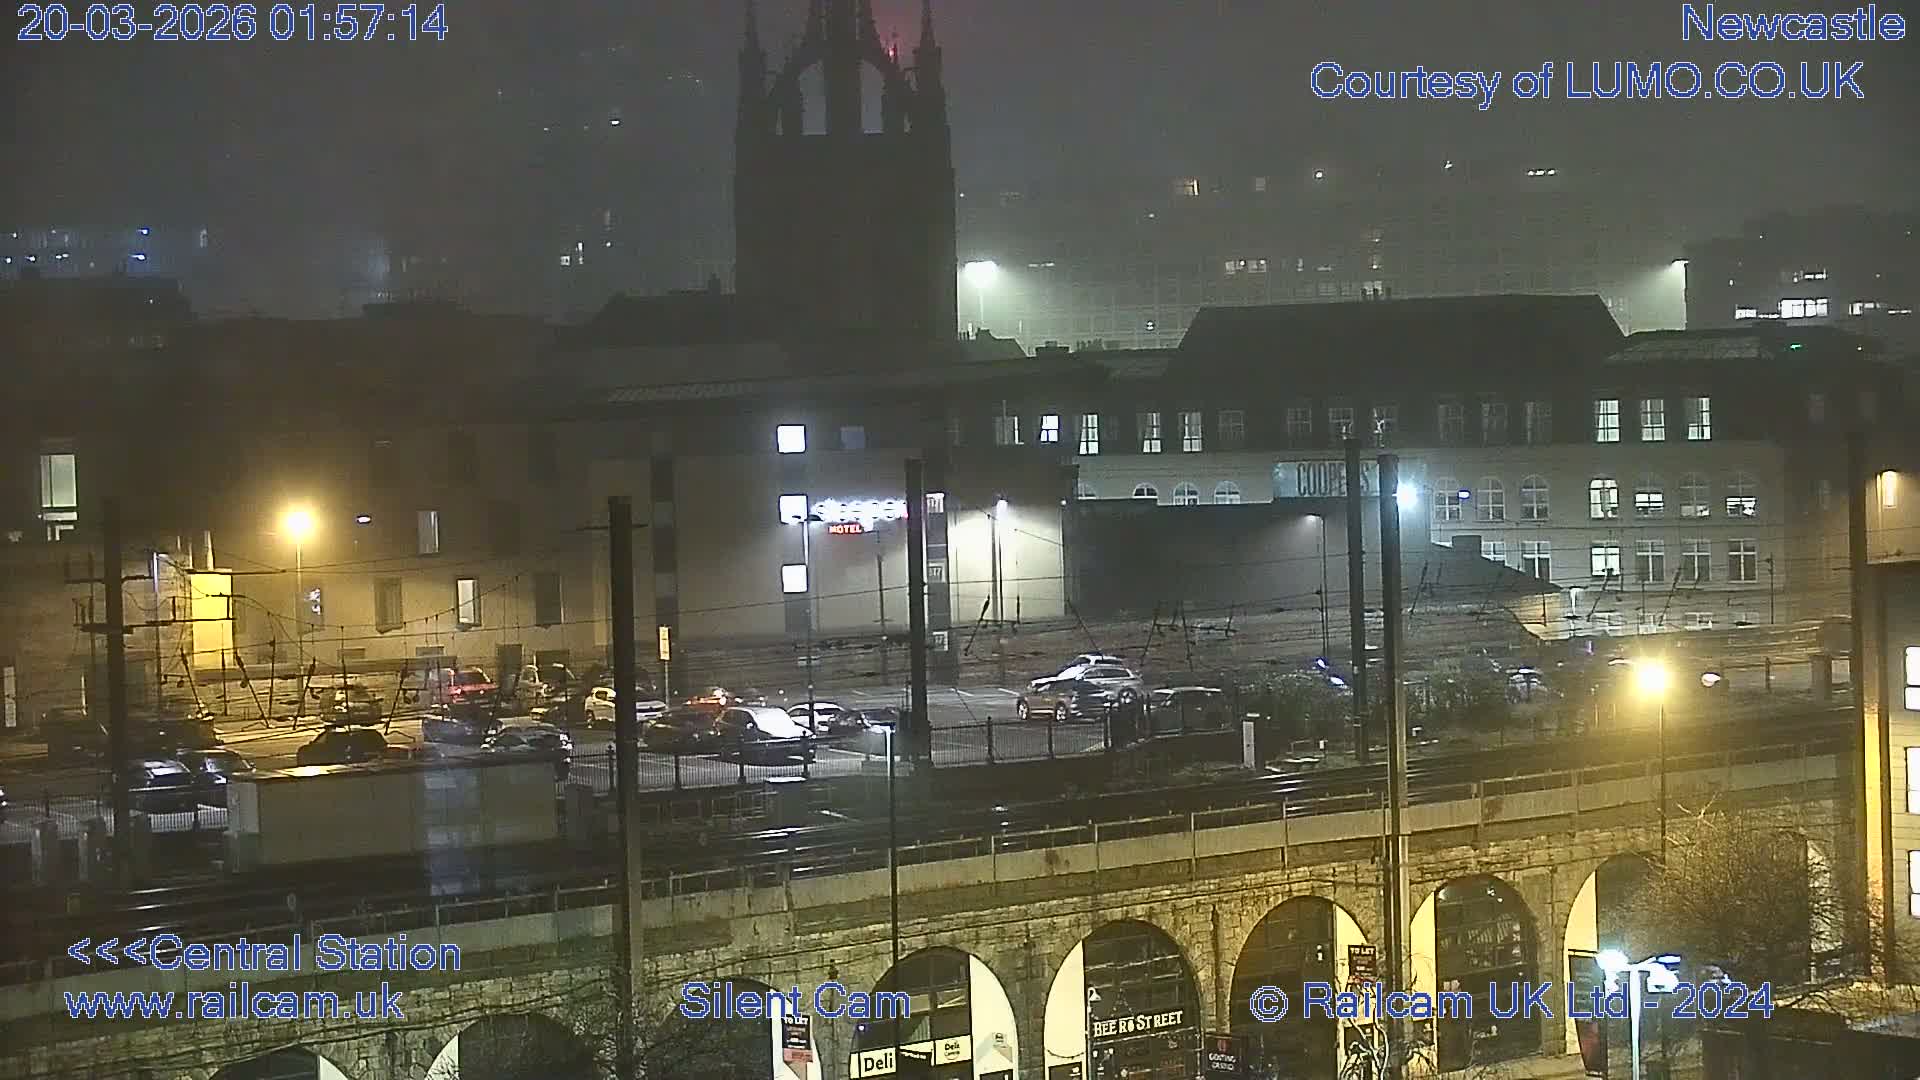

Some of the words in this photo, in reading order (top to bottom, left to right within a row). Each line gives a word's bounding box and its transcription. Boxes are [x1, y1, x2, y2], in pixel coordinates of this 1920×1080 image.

[1297, 462, 1370, 497] COOPES
[1136, 1010, 1183, 1031] STREET
[863, 1052, 893, 1072] Deli
